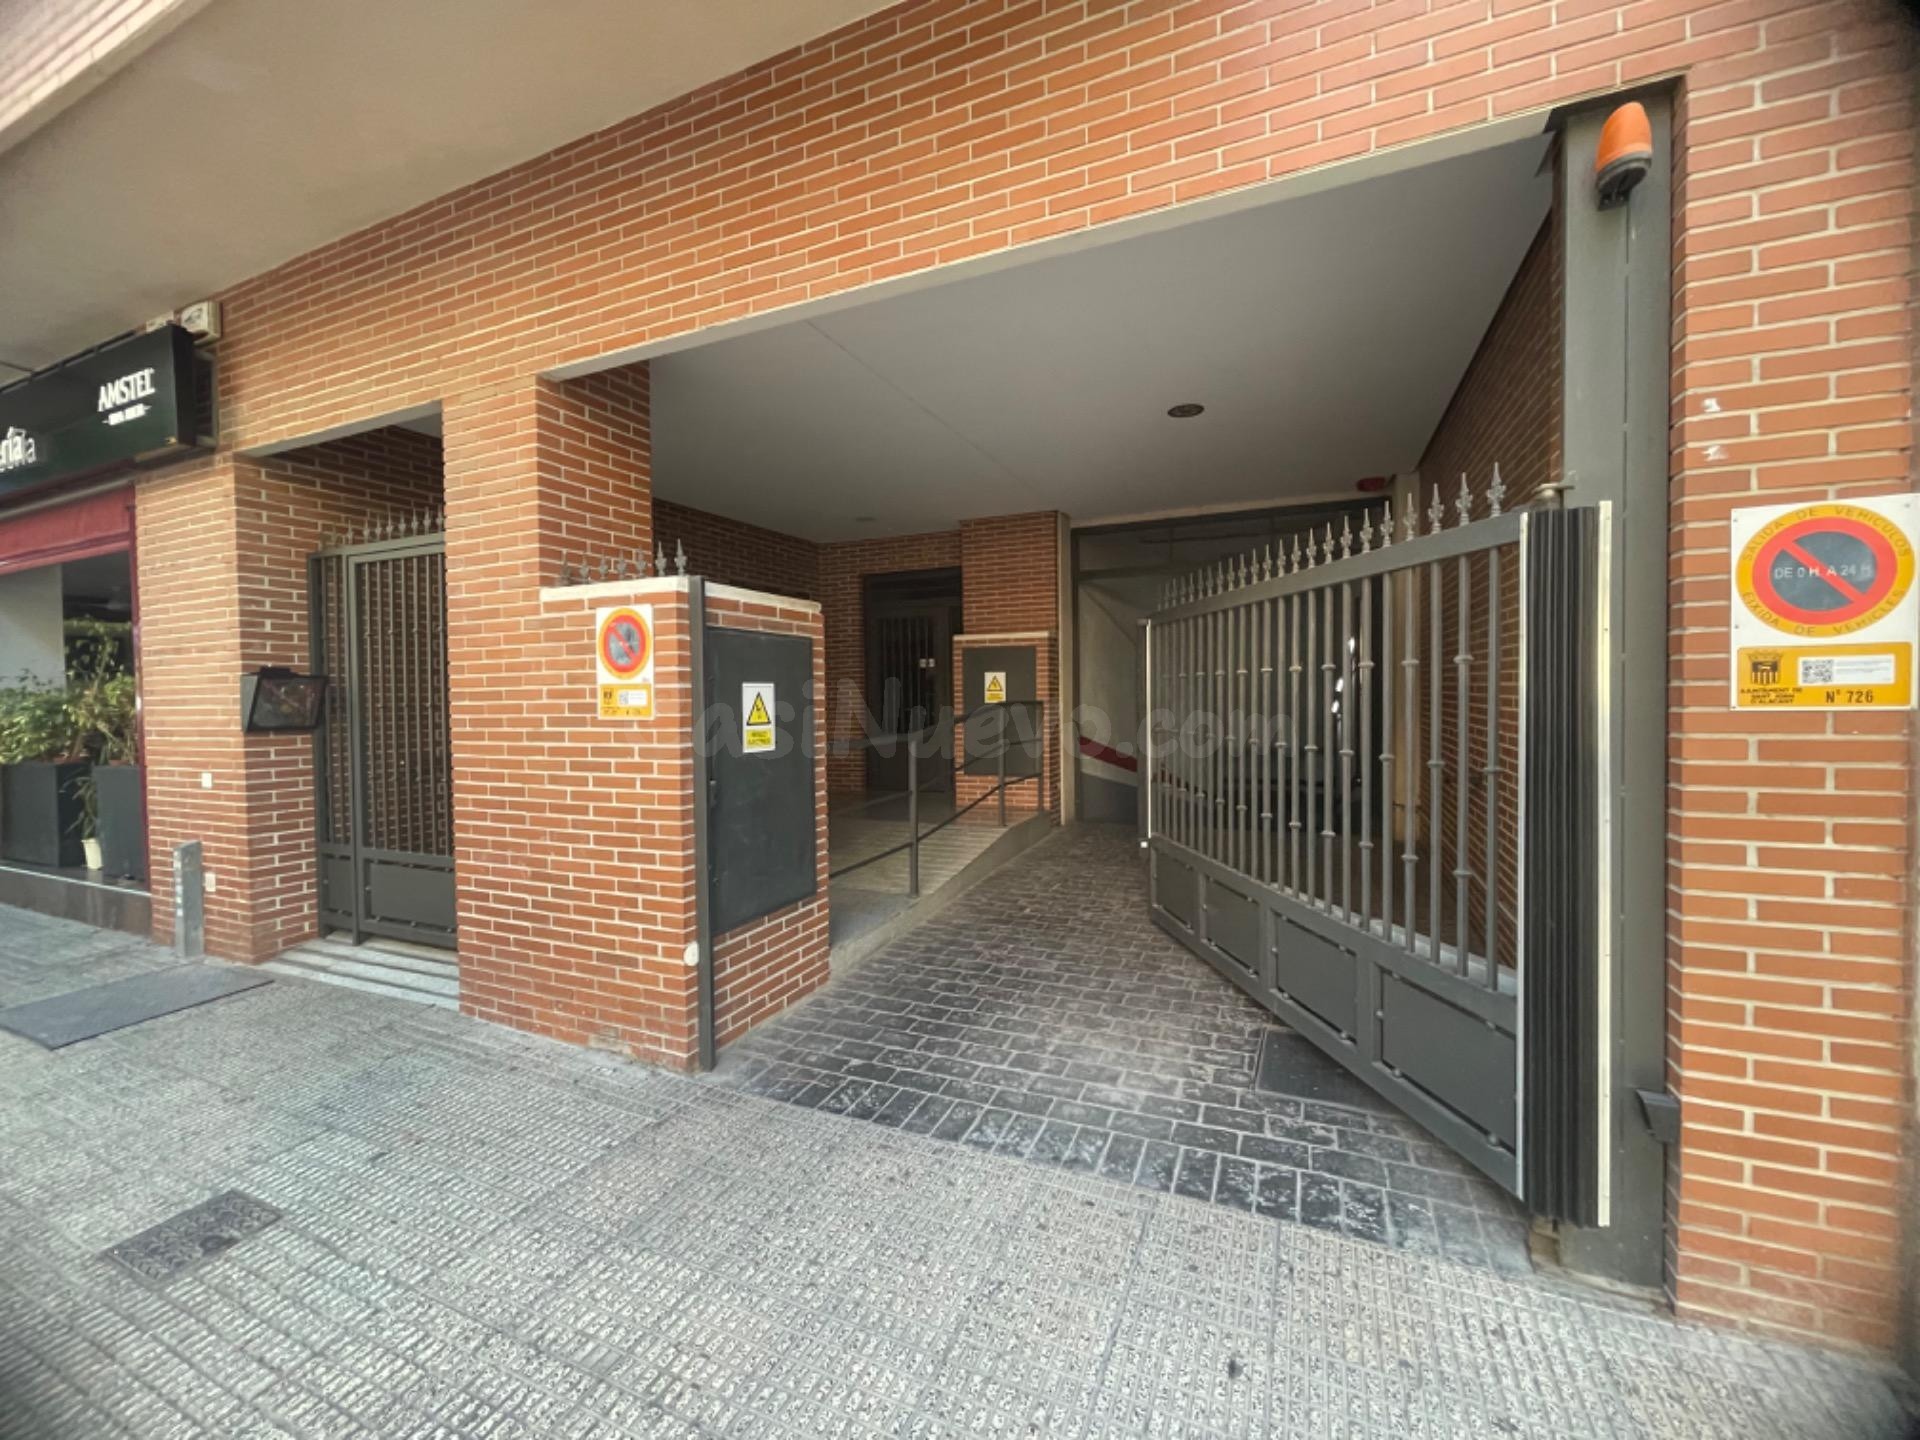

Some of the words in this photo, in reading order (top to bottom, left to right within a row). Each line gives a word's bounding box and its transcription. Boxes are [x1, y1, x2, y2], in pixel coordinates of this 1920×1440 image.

[97, 367, 156, 412] AMSTEL
[1742, 521, 1784, 561] SALIDA
[1795, 508, 1819, 521] DE
[1774, 567, 1793, 580] DE
[1808, 566, 1820, 577] H
[1825, 564, 1838, 576] A
[1840, 563, 1857, 576] 24
[1793, 624, 1817, 636] DE
[1847, 688, 1874, 704] 726
